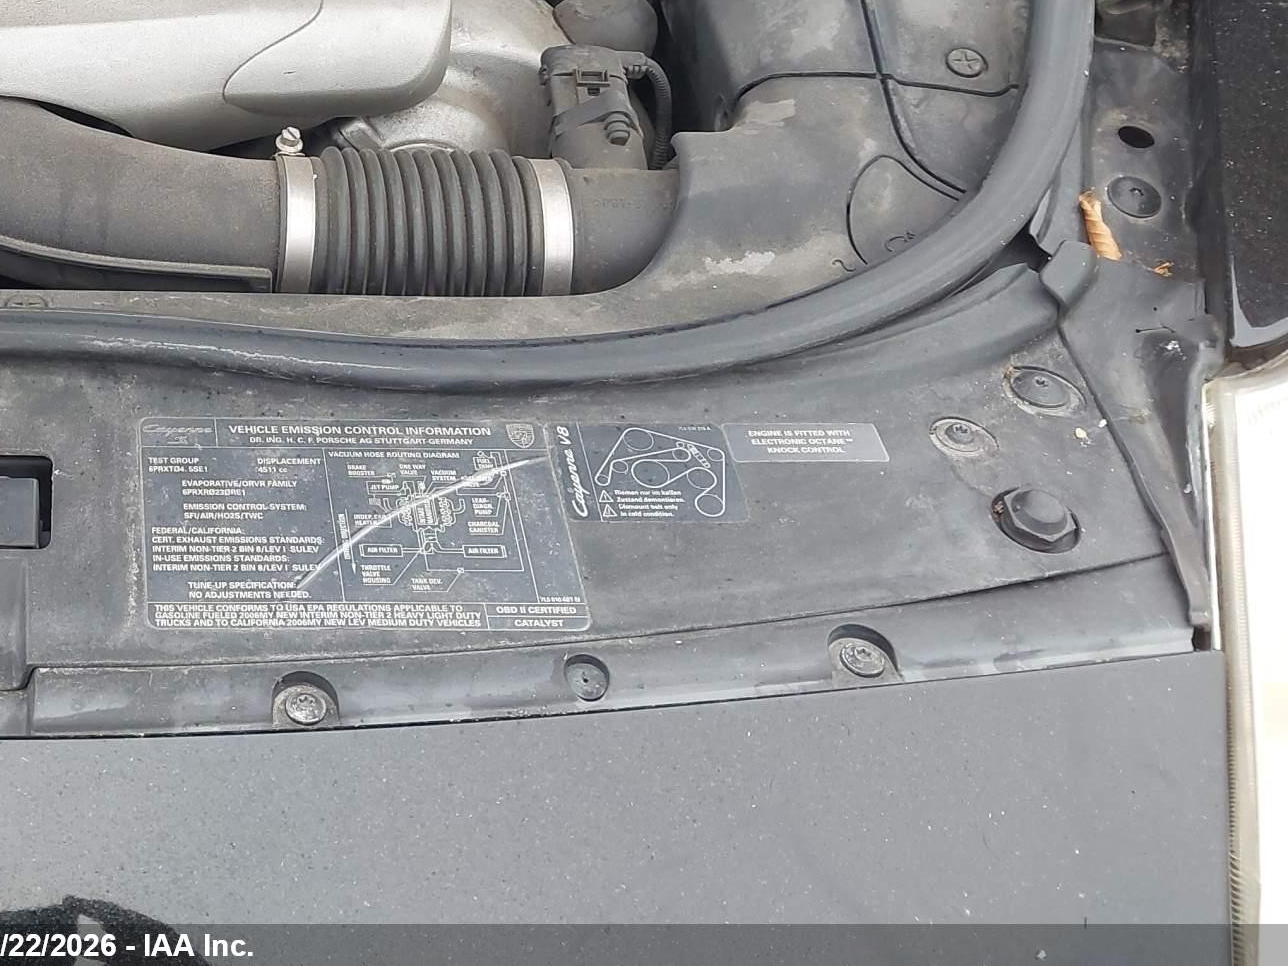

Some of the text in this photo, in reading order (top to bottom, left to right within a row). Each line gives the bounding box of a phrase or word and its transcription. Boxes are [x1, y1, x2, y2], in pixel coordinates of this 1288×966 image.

[229, 425, 492, 436] VEHICLE EMISSION CONTROL INFORMATION
[316, 436, 357, 444] PORSCHE
[751, 438, 807, 446] ELECTRONIC
[767, 446, 846, 454] KNOCK CONTROL
[327, 451, 459, 459] VACUUM HOSE ROUTING DIAGRAM
[556, 426, 590, 517] Cayenne V8
[267, 480, 297, 488] FAMILY
[183, 503, 225, 511] EMISSION
[176, 536, 217, 544] EXHAUST
[218, 536, 267, 544] EMISSIONS
[152, 545, 187, 553] INTERIM
[189, 545, 230, 553] NON-TIER
[231, 545, 237, 553] 2
[238, 545, 254, 553] BIN
[152, 554, 182, 562] IN-USE
[183, 554, 232, 562] EMISSIONS
[188, 581, 227, 589] TUNE-UP
[188, 591, 203, 599] NO
[204, 591, 271, 599] ADJUSTMENTS
[155, 604, 464, 612] THIS VEHICLE CONFORMS TO USA EPA REGULATIONS APPLICABLE TO
[496, 606, 518, 615] OBD
[527, 606, 577, 615] CERTIFIED
[155, 619, 191, 627] TRUCKS
[193, 619, 215, 627] AND
[216, 619, 228, 627] TO
[230, 619, 285, 627] CALIFORNIA
[323, 619, 346, 627] NEW
[347, 619, 366, 627] LEV
[368, 619, 407, 627] MEDIUM
[409, 619, 435, 627] DUTY
[436, 619, 481, 627] VEHICLES
[514, 619, 564, 627] CATALYST
